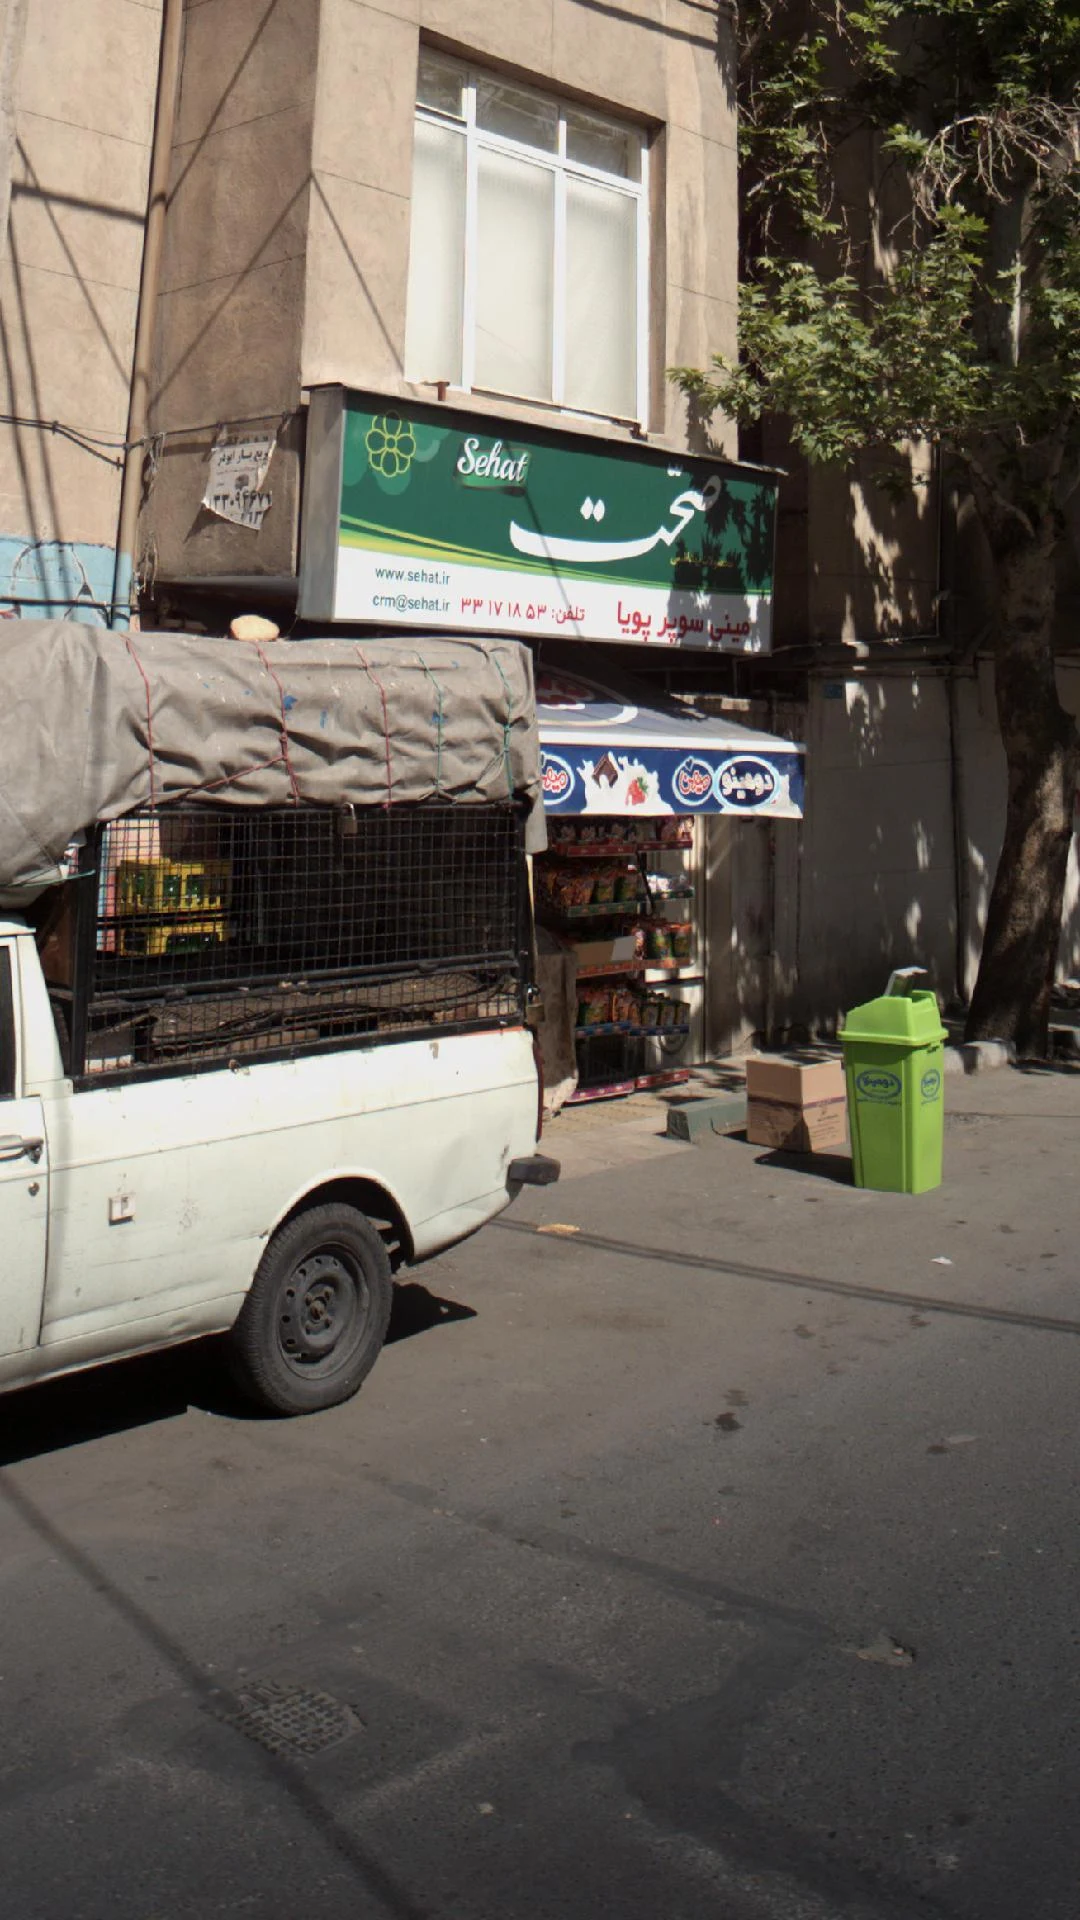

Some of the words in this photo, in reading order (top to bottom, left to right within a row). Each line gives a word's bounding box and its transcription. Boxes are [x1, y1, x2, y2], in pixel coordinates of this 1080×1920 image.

[457, 438, 529, 482] Sehat
[375, 567, 450, 585] www.sehat.ir
[372, 594, 450, 612] crm@sehat.ir
[617, 601, 651, 642] پویا
[657, 614, 704, 643] سوپر
[709, 613, 750, 642] مینی
[721, 767, 773, 799] دومینو
